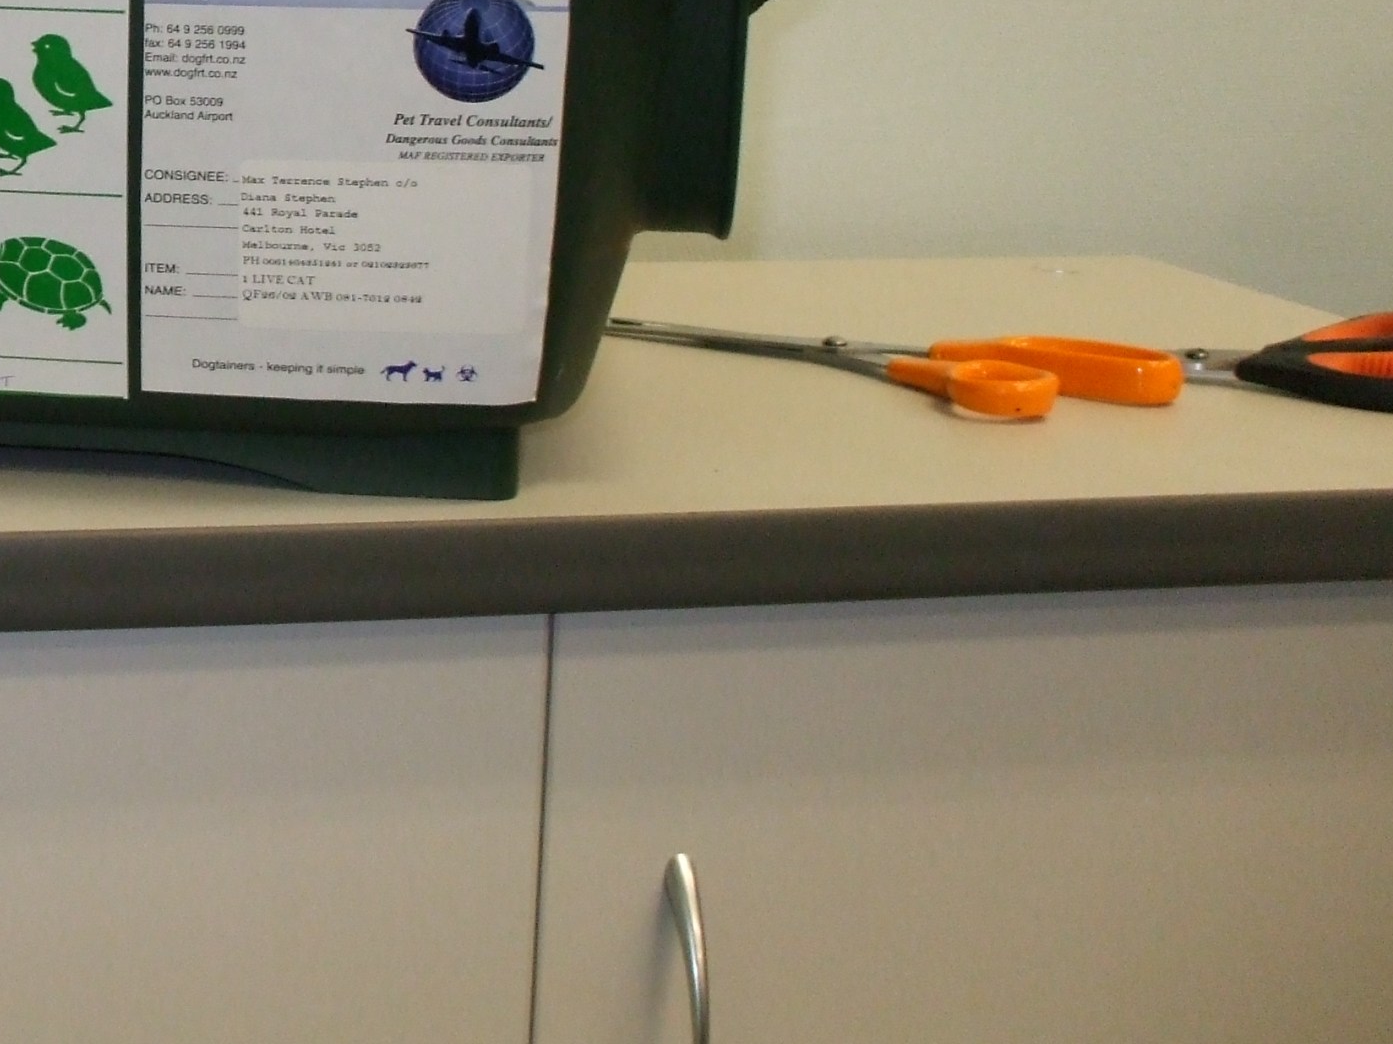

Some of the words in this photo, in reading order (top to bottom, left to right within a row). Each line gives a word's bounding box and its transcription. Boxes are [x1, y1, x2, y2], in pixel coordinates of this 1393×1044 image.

[145, 23, 163, 33] Ph:
[167, 24, 180, 33] 64
[183, 25, 190, 34] 9
[194, 25, 214, 34] 256
[217, 26, 245, 35] 0999
[168, 39, 181, 48] 64
[185, 39, 191, 48] 9
[195, 39, 215, 49] 256
[220, 40, 246, 49] 1994
[145, 52, 178, 62] Email:
[182, 54, 246, 65] dogfrt.co.nz
[145, 68, 237, 79] www.dogfrt.co.nz
[145, 95, 161, 105] PO
[166, 96, 186, 106] Box
[190, 96, 223, 106] 53009
[145, 110, 194, 120] Auckland
[197, 112, 233, 122] Airport
[393, 113, 415, 126] Pet
[420, 114, 461, 126] Travel
[466, 114, 554, 128] Consultants/
[385, 133, 448, 146] Dangerous
[452, 134, 486, 145] Goods
[490, 134, 558, 147] Consultants
[398, 151, 422, 160] MAF
[424, 152, 489, 161] REGISTERED
[491, 153, 545, 162] EXPORTER
[144, 169, 228, 182] CONSIGNEE:
[242, 176, 265, 185] Max
[272, 176, 330, 186] Terrence
[337, 177, 389, 188] Stephen
[144, 193, 212, 205] ADDRESS:
[284, 193, 336, 204] Stephen
[243, 208, 263, 216] 441
[271, 208, 307, 219] Royal
[315, 209, 358, 219] Parade
[242, 224, 293, 234] Carlton
[300, 225, 336, 235] Hotel
[323, 243, 346, 251] Vic
[243, 256, 259, 265] PH
[144, 263, 180, 274] ITEM:
[253, 275, 284, 284] LIVE
[287, 275, 315, 285] CAT
[145, 285, 186, 296] NAME:
[192, 358, 255, 371] Dogtainers
[267, 361, 313, 376] keeping
[317, 364, 323, 373] it
[327, 364, 365, 376] simple
